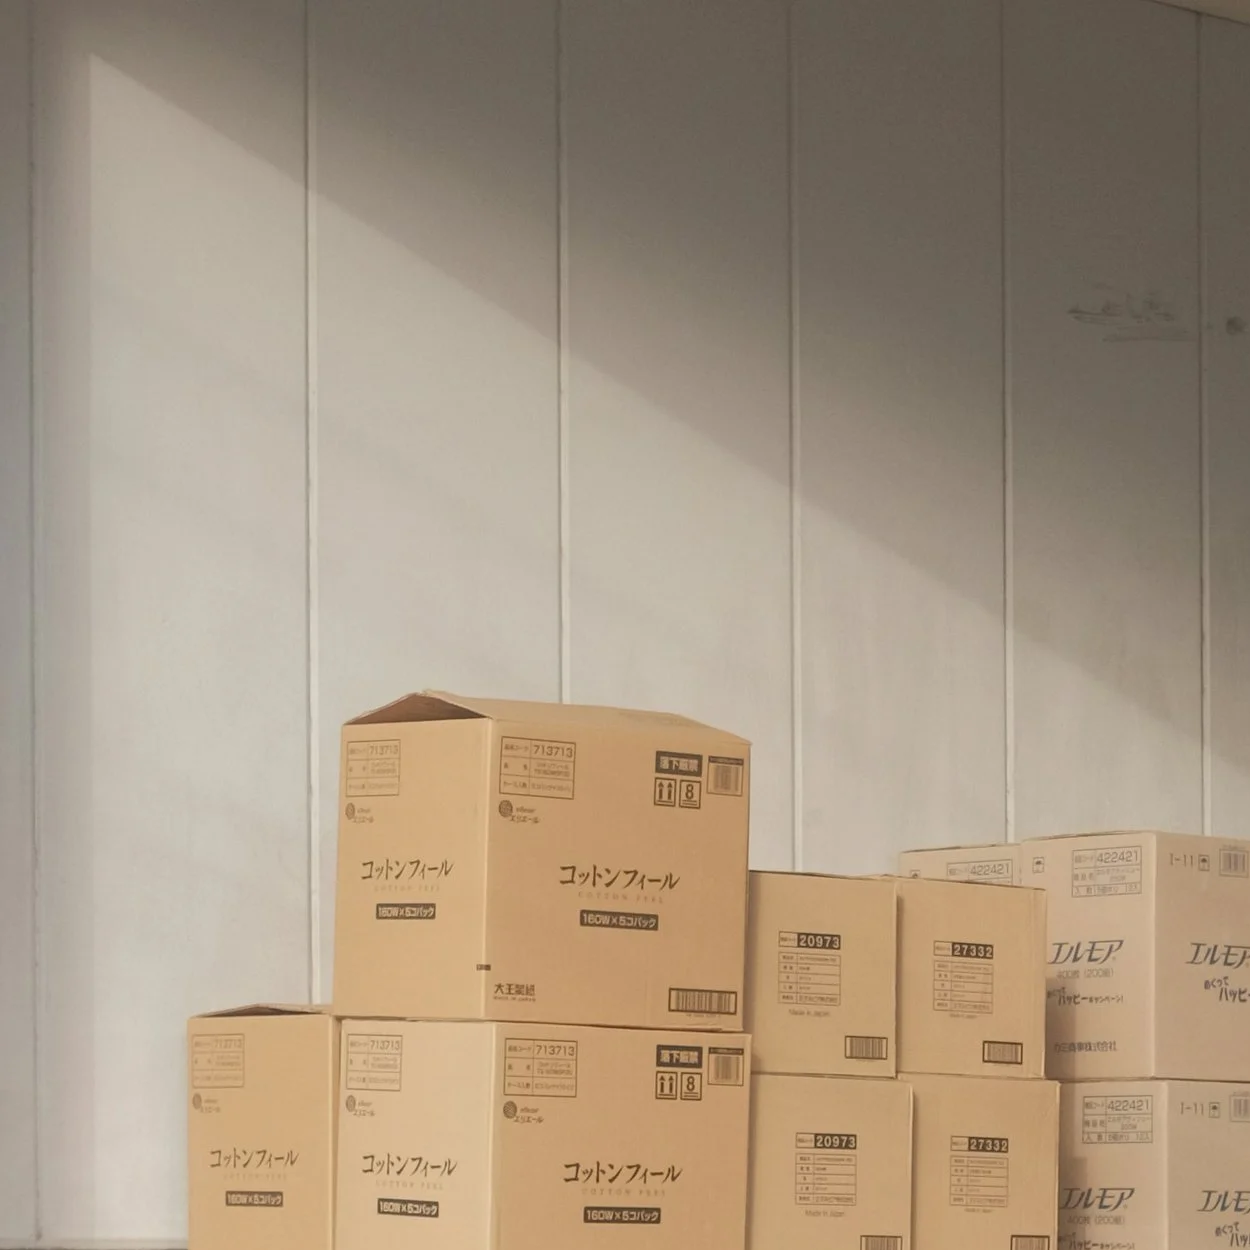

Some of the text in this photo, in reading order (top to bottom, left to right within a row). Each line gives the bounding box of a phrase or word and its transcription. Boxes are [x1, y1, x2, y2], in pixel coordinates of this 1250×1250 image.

[534, 744, 573, 758] 713713
[685, 783, 694, 800] 8
[1097, 850, 1138, 863] 422421
[361, 859, 454, 881] コットンフィール
[559, 864, 681, 890] コットンフィール
[970, 863, 1010, 877] 422421
[582, 912, 657, 928] 160W×5コパック
[799, 934, 840, 949] 20973
[953, 943, 993, 959] 27332
[1047, 940, 1124, 964] エルモア
[370, 1039, 401, 1052] 713713
[536, 1044, 575, 1056] 713713
[686, 1075, 696, 1092] 8
[1108, 1099, 1149, 1111] 422421
[816, 1135, 857, 1149] 20973
[969, 1138, 1009, 1153] 27332
[209, 1147, 299, 1169] コットンフィール
[361, 1153, 458, 1177] コットンフィール
[563, 1160, 683, 1185] コットンフィール
[1060, 1188, 1135, 1211] エルモア
[379, 1201, 437, 1216] 160W×5コパック
[586, 1208, 660, 1223] 160W×5コパック
